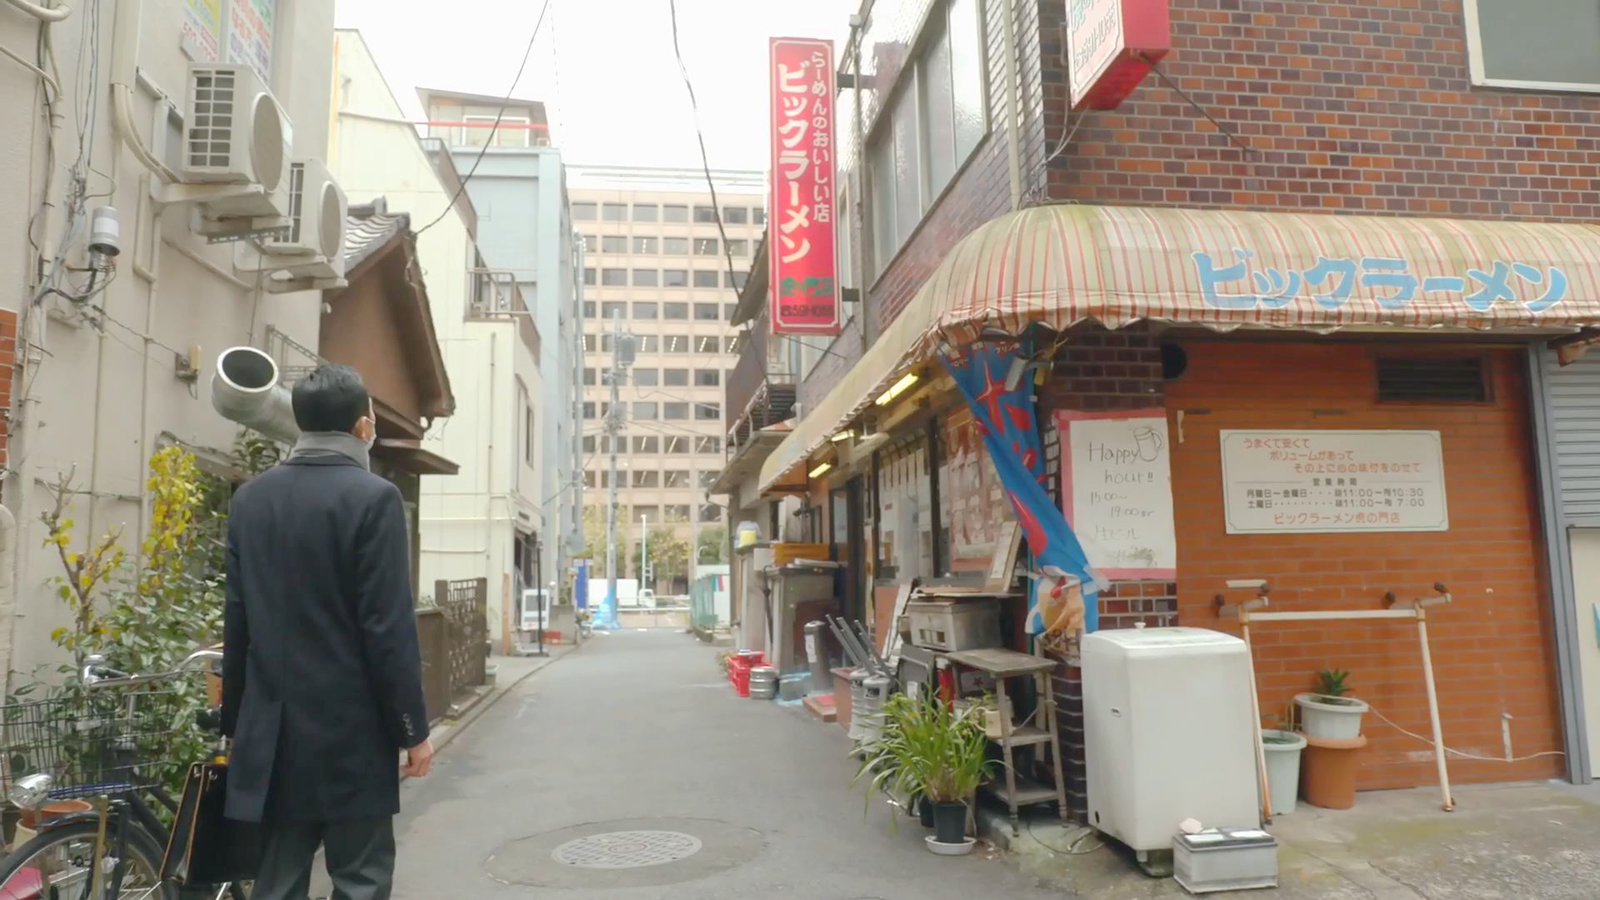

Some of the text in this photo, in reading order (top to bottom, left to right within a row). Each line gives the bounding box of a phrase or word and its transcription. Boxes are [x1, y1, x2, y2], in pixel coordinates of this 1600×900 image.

[811, 51, 830, 222] らーめんのおいしい店
[778, 60, 811, 264] ビックラーメン
[1191, 248, 1567, 312] ビックラーメン
[1089, 441, 1138, 464] Happy
[1243, 438, 1310, 449] うまくて安くて
[1269, 451, 1354, 461] ボリュームがあって
[1274, 512, 1401, 524] ビックラーメン虎の門店
